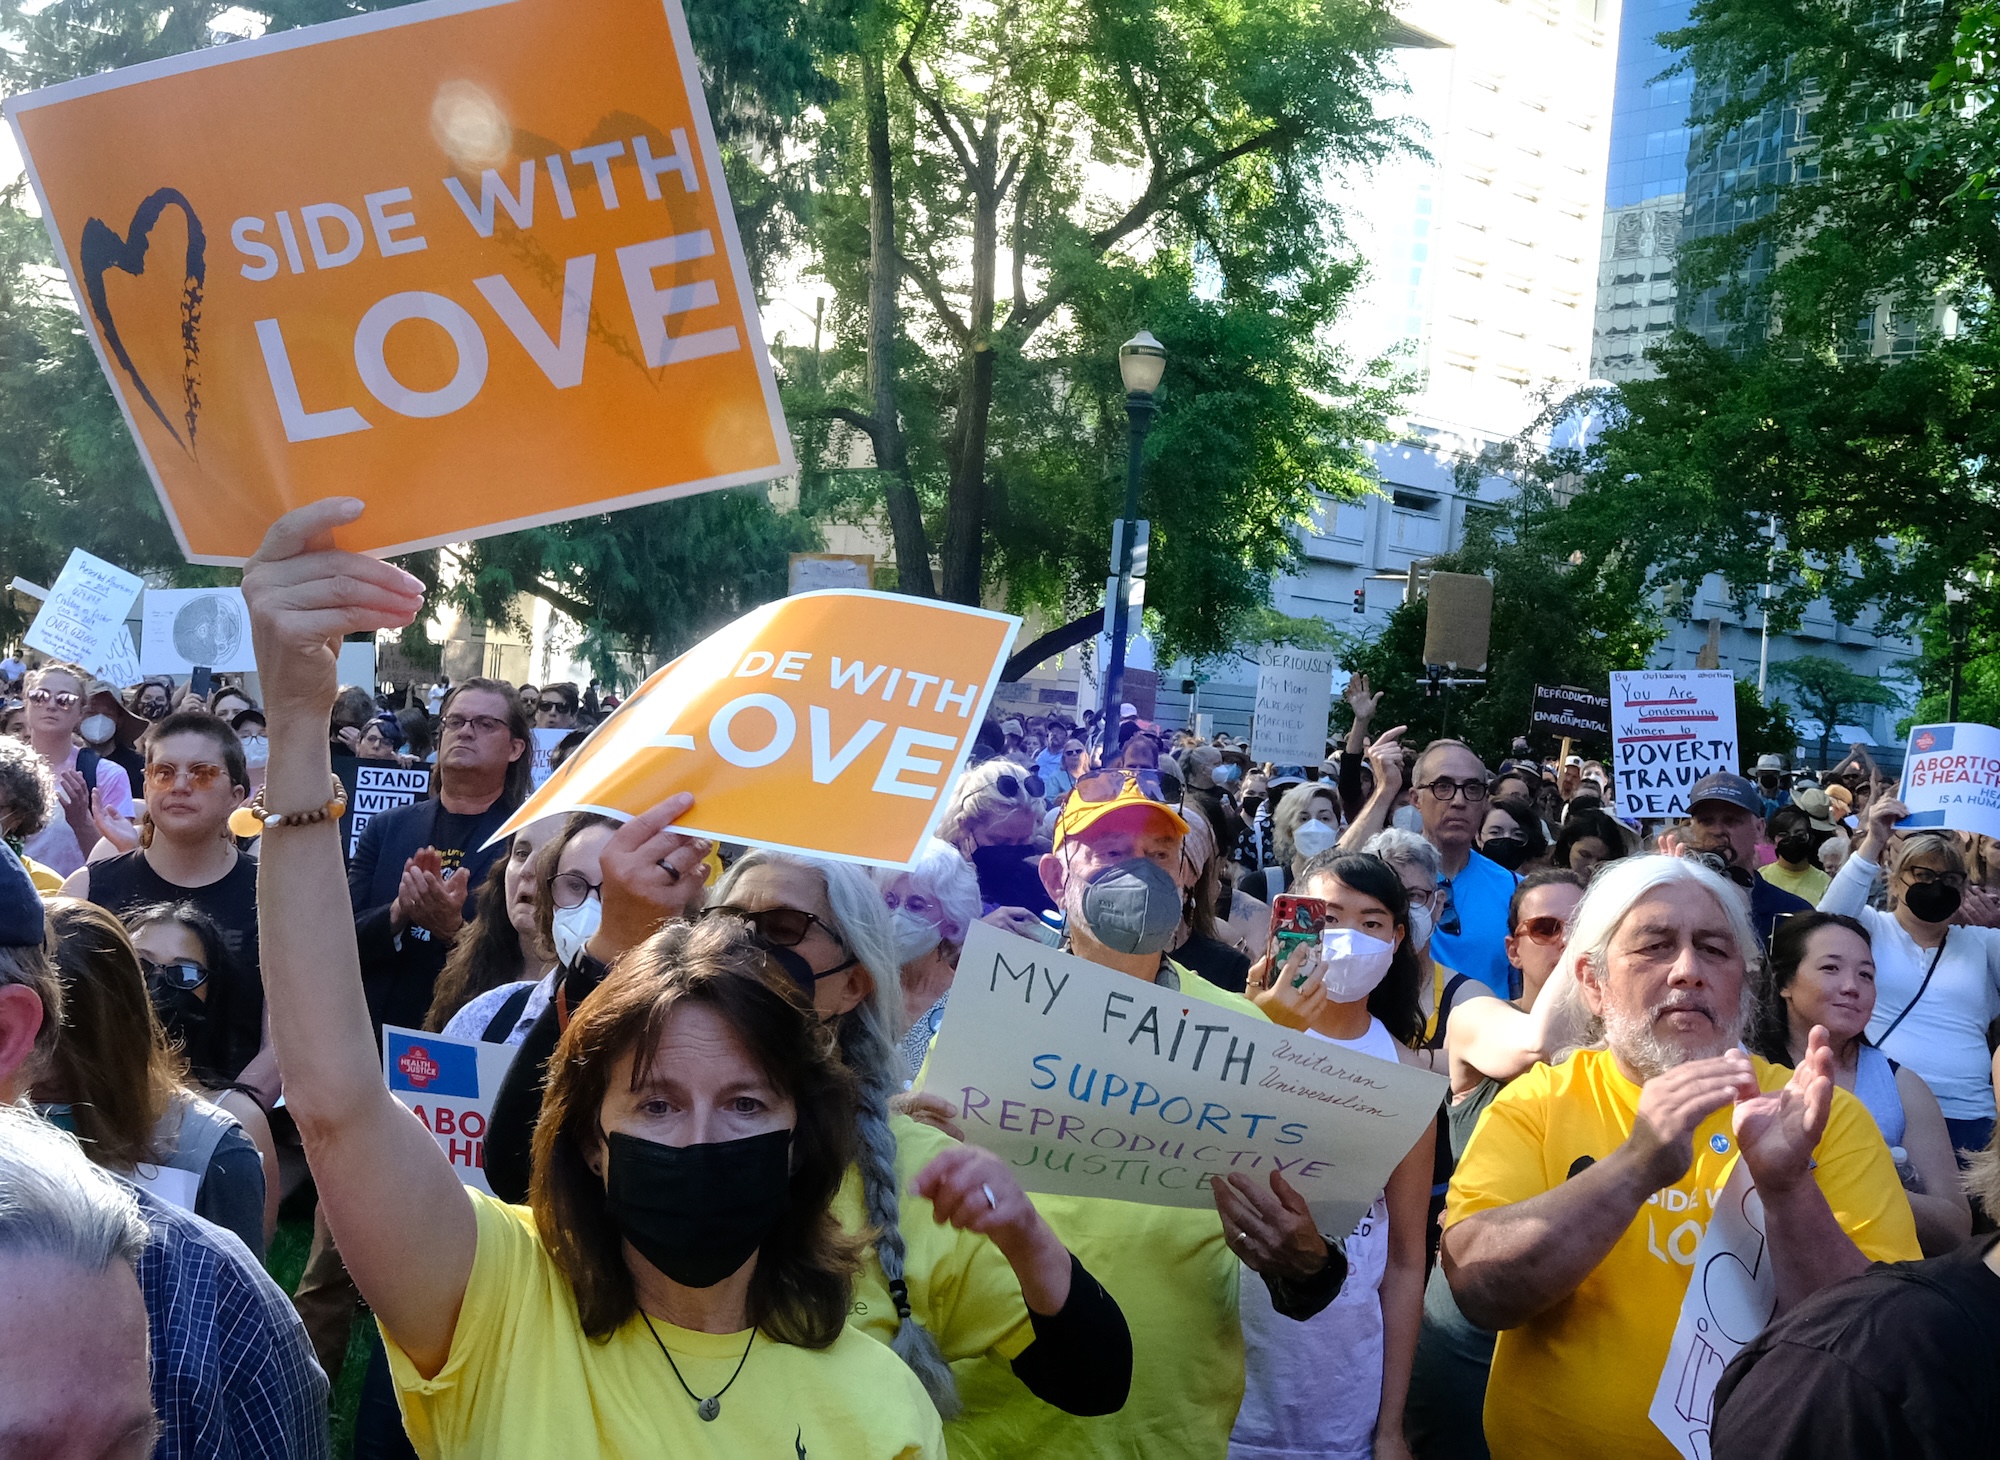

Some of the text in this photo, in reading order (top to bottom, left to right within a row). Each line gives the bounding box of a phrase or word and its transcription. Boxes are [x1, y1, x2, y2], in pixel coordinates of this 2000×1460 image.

[230, 127, 699, 282] SIDE WITH
[254, 229, 741, 443] LOVE
[45, 615, 68, 634] OVER
[830, 656, 979, 718] WITH
[1615, 673, 1628, 682] By
[1537, 686, 1609, 708] REPRODUCTIVE
[1621, 682, 1695, 702] You Are
[1534, 711, 1609, 733] ENVIRONMENTAL
[1620, 723, 1666, 736] Women
[360, 770, 426, 789] STAND
[1911, 773, 1927, 788] IS
[358, 794, 411, 810] WITH
[1939, 794, 1950, 804] IS
[1953, 794, 1963, 804] A
[989, 952, 1070, 1016] MY
[400, 1058, 431, 1068] HEALTH
[405, 1064, 437, 1077] JUSTICE
[1271, 1039, 1389, 1090] Unitarian
[1030, 1053, 1310, 1145] SUPPORTS
[1258, 1065, 1399, 1118] Universalism
[960, 1086, 1336, 1180] REPRODUCTIVE
[1011, 1146, 1228, 1191] JUSTICE
